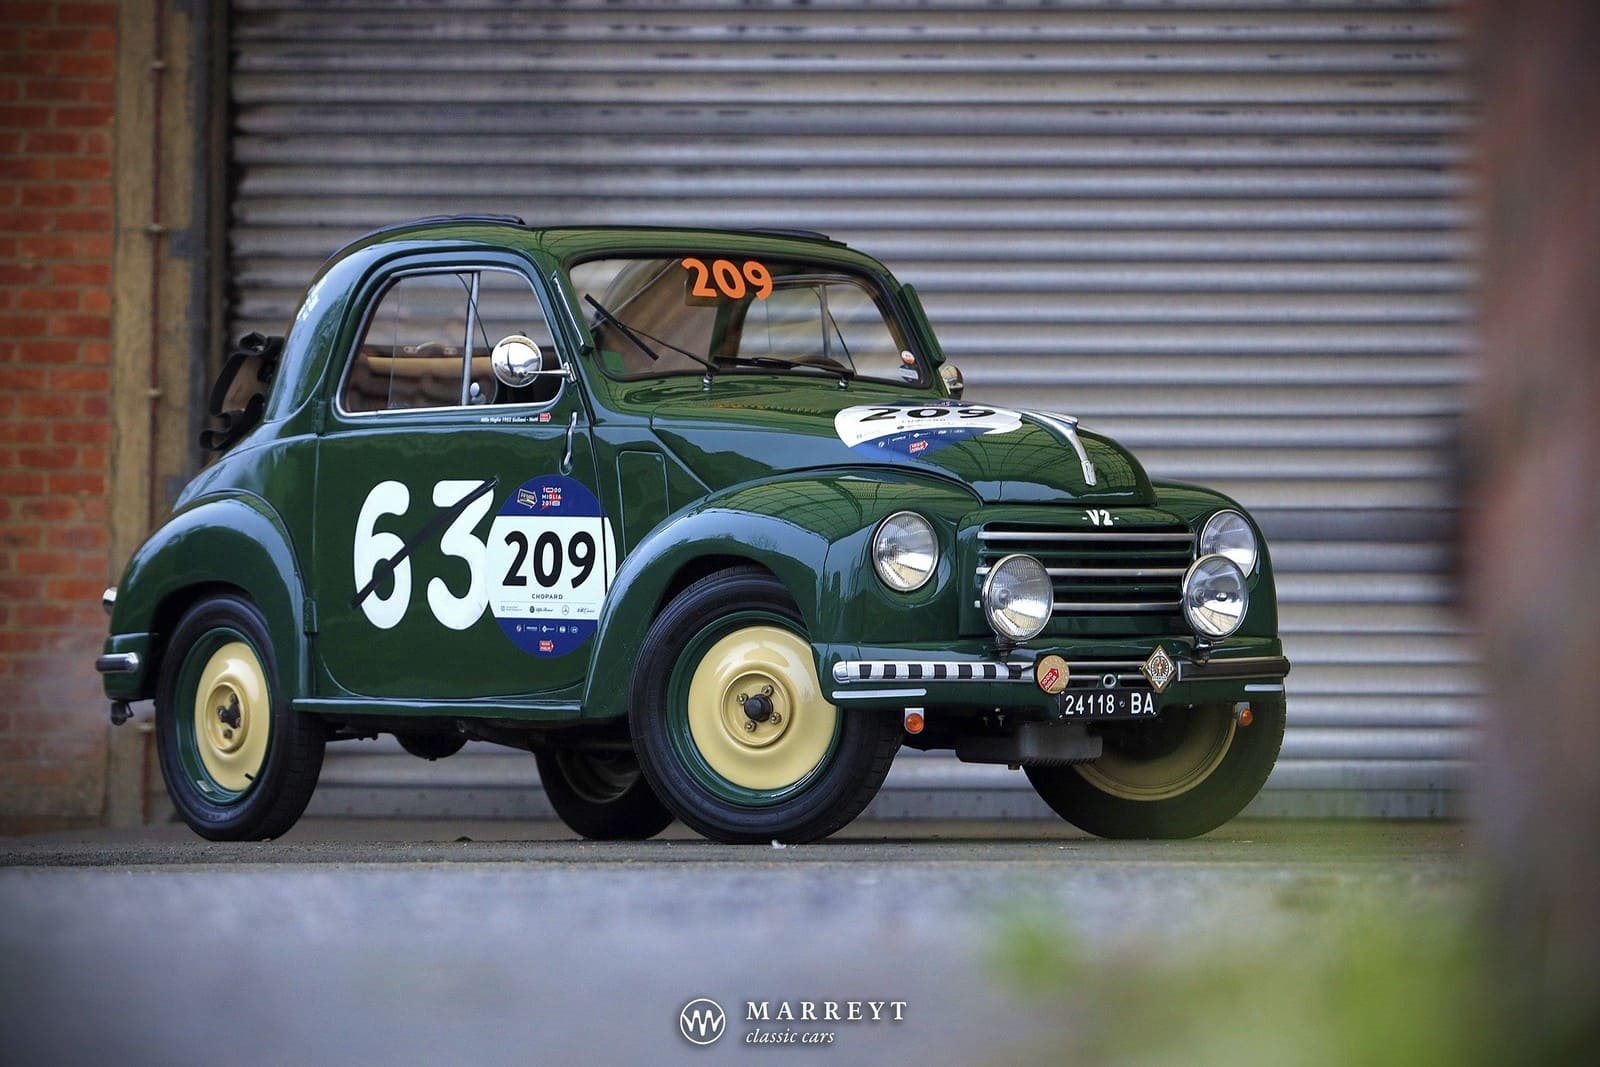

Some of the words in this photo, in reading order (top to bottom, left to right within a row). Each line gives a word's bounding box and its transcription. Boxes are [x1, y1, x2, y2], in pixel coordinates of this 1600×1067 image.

[681, 257, 773, 300] 209
[859, 407, 996, 422] 209
[353, 479, 495, 631] 63
[502, 530, 596, 589] 209
[1065, 694, 1115, 715] 24118
[1130, 692, 1154, 715] BA
